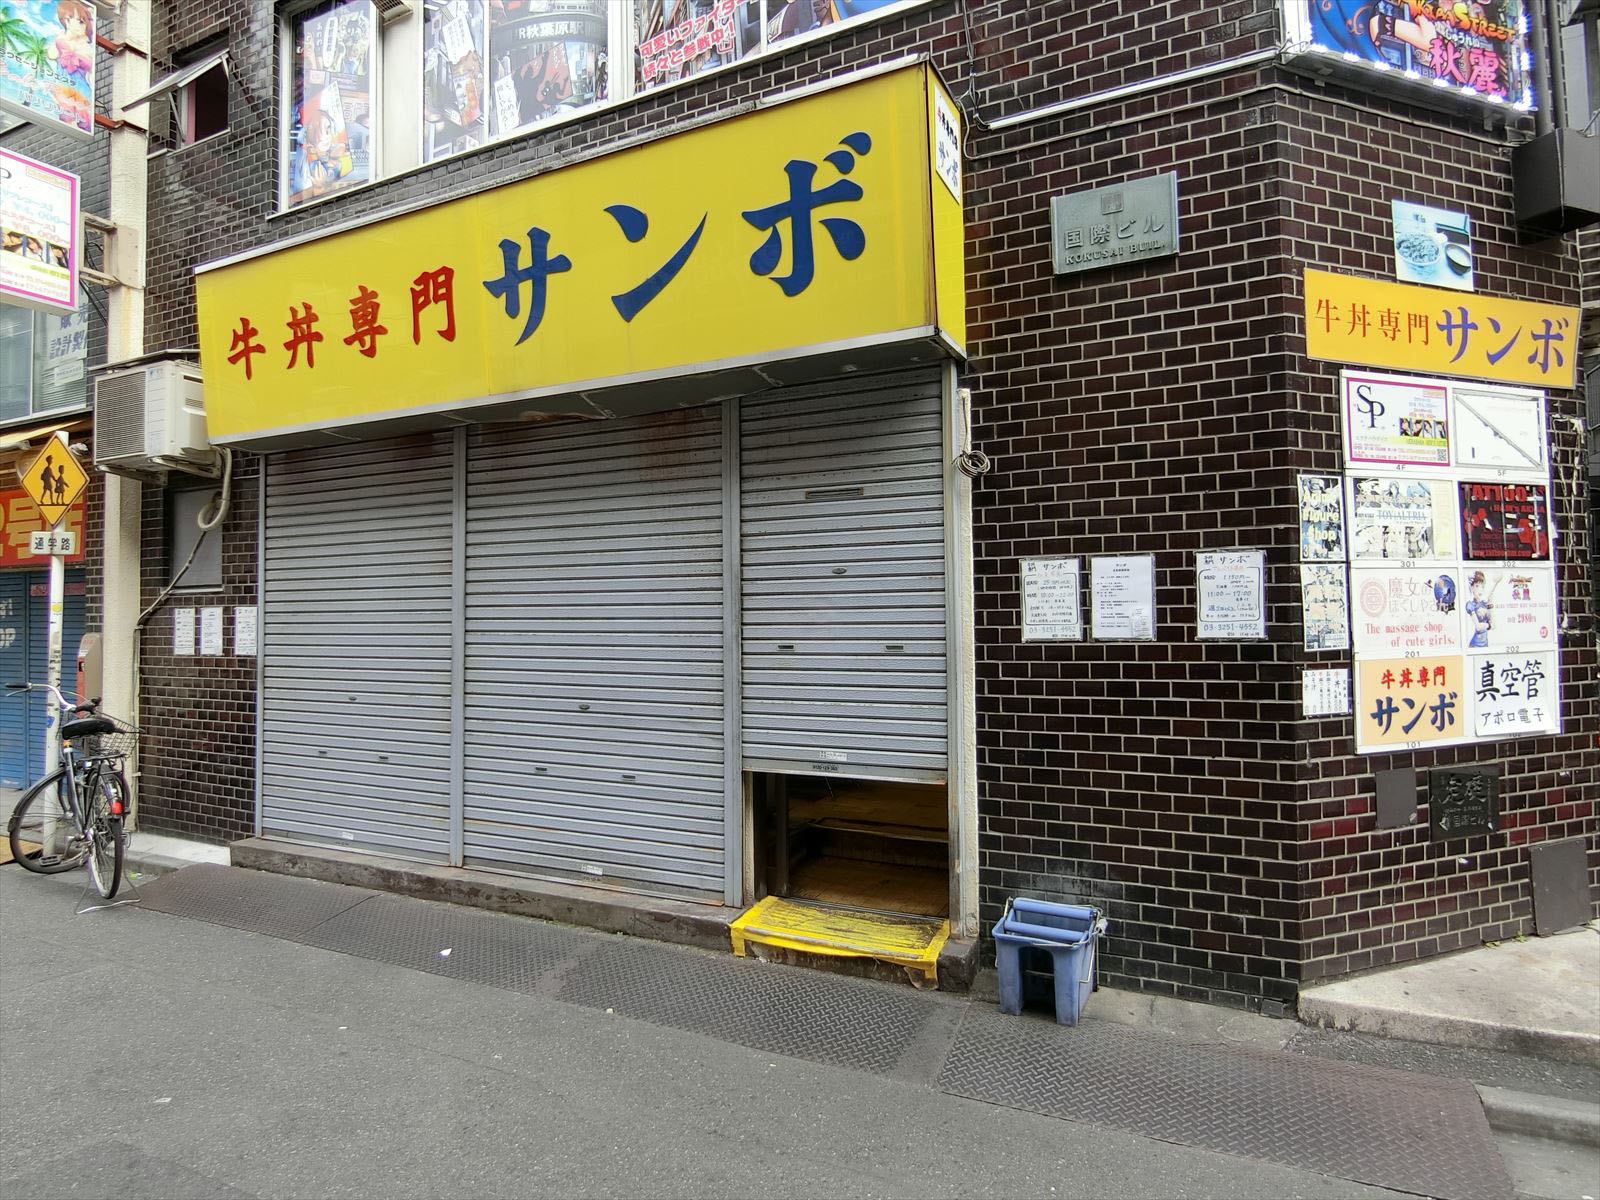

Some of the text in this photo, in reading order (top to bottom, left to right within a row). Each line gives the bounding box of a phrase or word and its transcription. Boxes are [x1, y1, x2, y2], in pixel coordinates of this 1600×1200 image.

[1065, 215, 1165, 250] 国際ビル
[227, 131, 873, 382] 牛丼専門 サンボ
[1065, 248, 1124, 266] KOKUSAI
[1315, 299, 1569, 374] 牛丼専門 サンボ
[34, 536, 71, 551] 通学路
[1365, 621, 1443, 634] The massage shop
[1391, 635, 1456, 648] of cute girls.
[1380, 665, 1446, 690] 牛丼専門
[1476, 659, 1545, 702] 真空管
[1370, 691, 1458, 737] サンボ
[1481, 707, 1544, 726] アポロ電子
